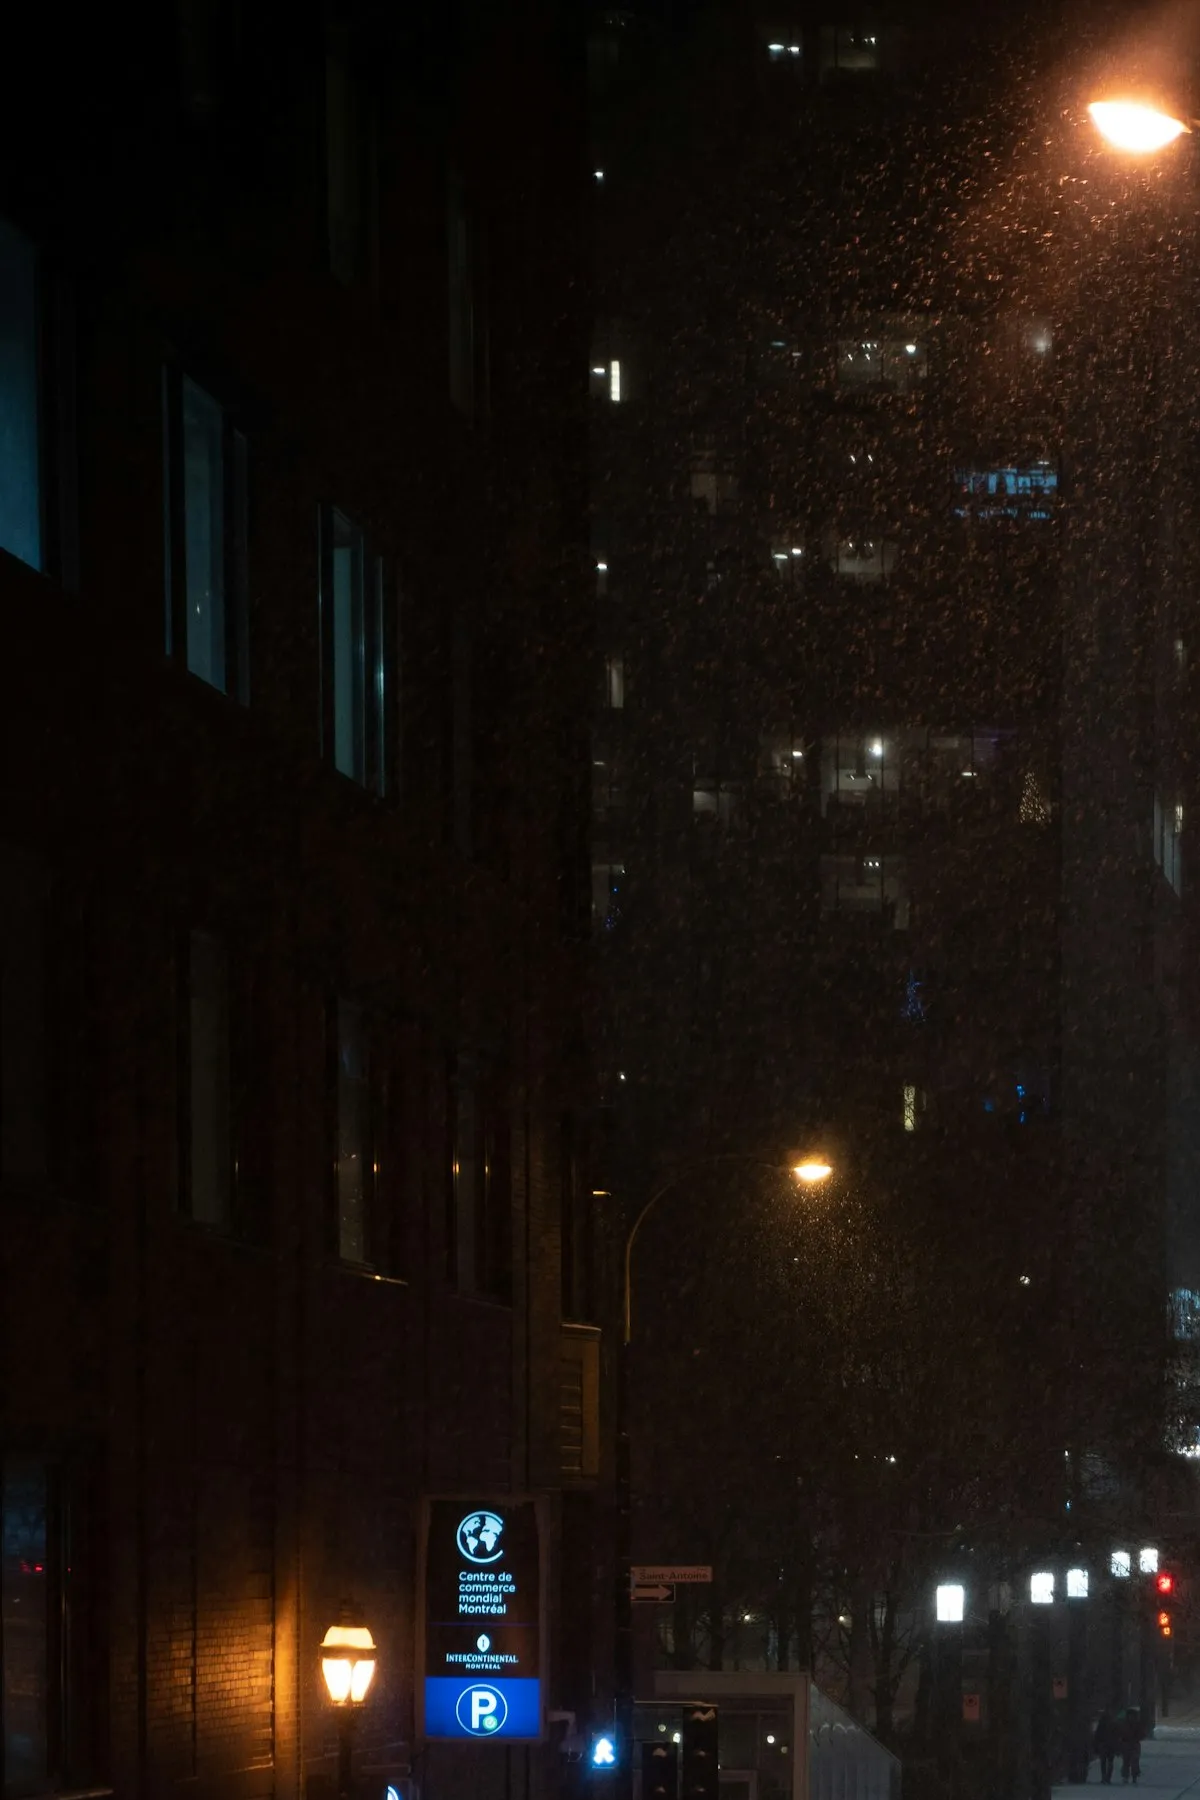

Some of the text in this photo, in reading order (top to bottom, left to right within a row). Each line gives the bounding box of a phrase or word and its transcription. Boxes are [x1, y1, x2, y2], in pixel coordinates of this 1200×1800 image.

[459, 1571, 513, 1582] Centre de
[459, 1584, 516, 1593] commerce
[459, 1593, 503, 1603] mondial
[459, 1603, 507, 1614] Montréal
[471, 1691, 497, 1729] P
